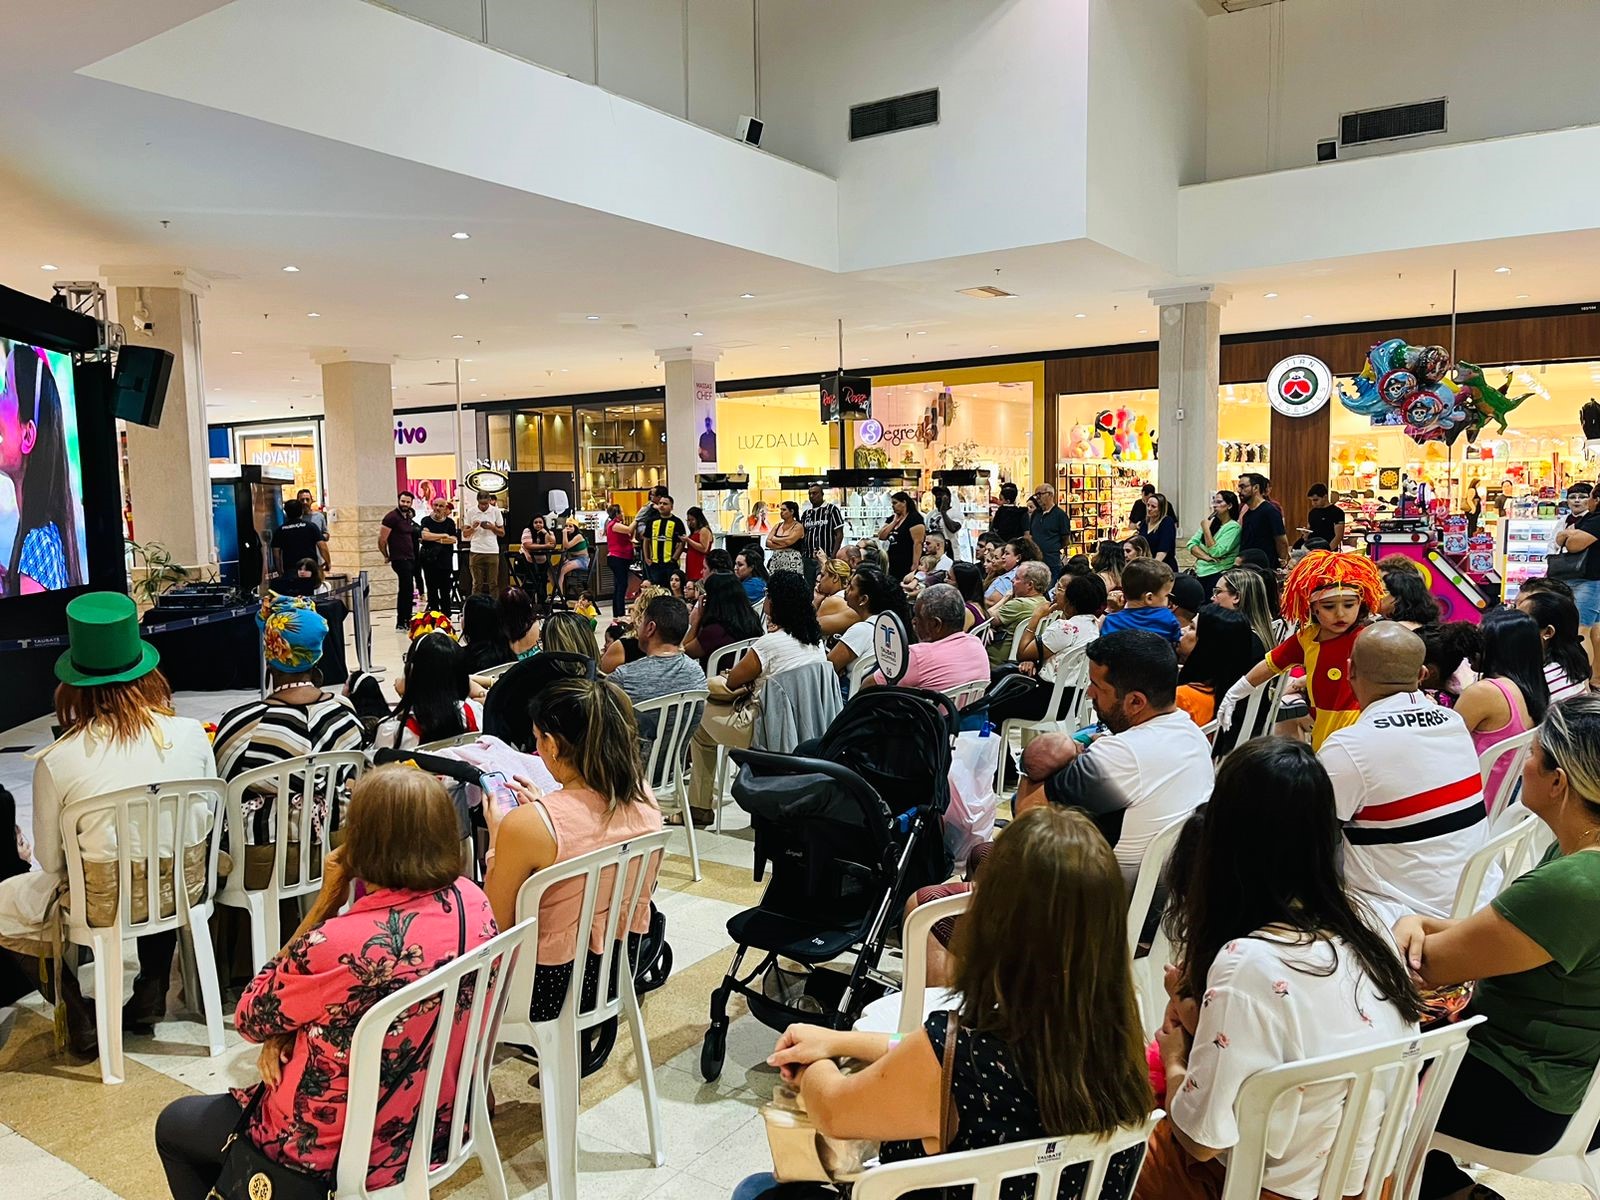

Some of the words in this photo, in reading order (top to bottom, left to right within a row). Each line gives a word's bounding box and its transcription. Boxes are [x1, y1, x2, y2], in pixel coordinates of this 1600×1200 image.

[738, 434, 764, 449] LUZ
[766, 433, 788, 448] DA
[790, 431, 820, 447] LUA
